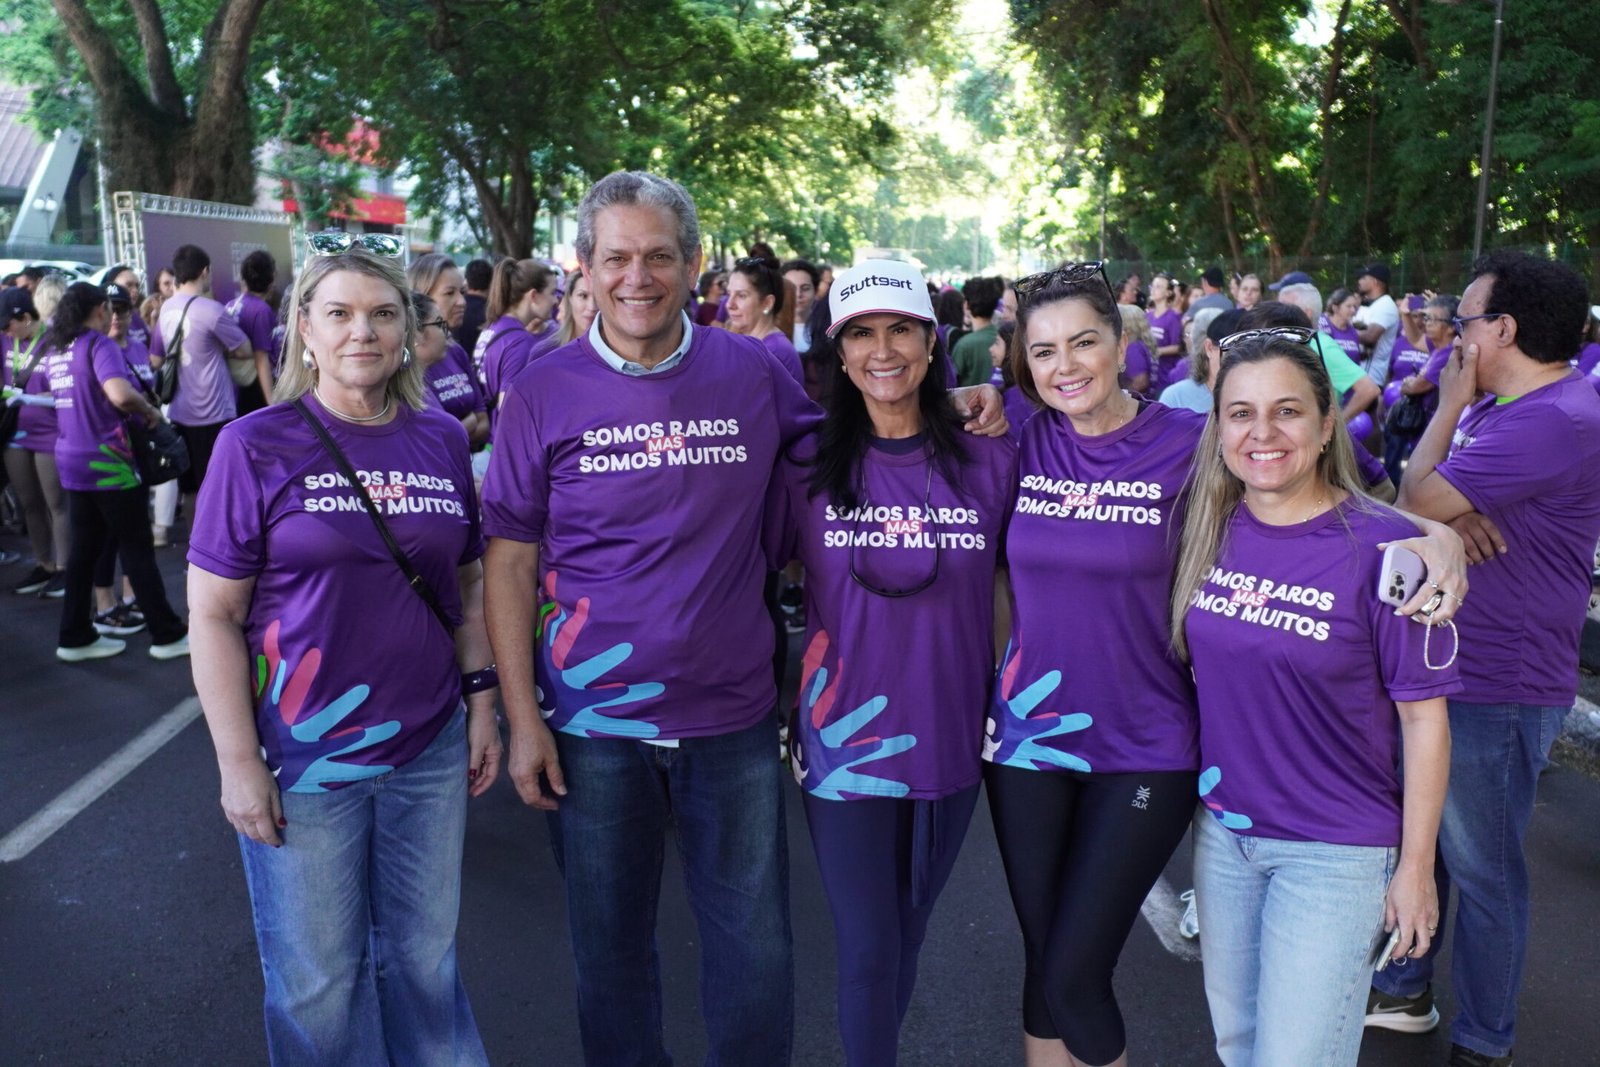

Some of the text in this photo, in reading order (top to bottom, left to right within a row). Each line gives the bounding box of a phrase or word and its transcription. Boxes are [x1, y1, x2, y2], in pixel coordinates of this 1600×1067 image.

[840, 275, 913, 302] Stuttgart
[582, 418, 740, 447] SOMOS RAROS
[648, 436, 683, 452] MAS
[579, 445, 748, 473] SOMOS MUITOS
[368, 486, 404, 499] MAS
[389, 471, 455, 493] RAROS
[1020, 474, 1162, 500] SOMOS RAROS
[388, 496, 465, 517] MUITOS
[1064, 494, 1097, 506] MAS
[908, 506, 979, 525] RAROS
[1074, 505, 1162, 526] MUITOS
[886, 520, 921, 534] MAS
[824, 530, 986, 550] SOMOS MUITOS
[1233, 590, 1267, 607] MAS
[1258, 578, 1335, 611] RAROS
[1240, 605, 1331, 641] MUITOS
